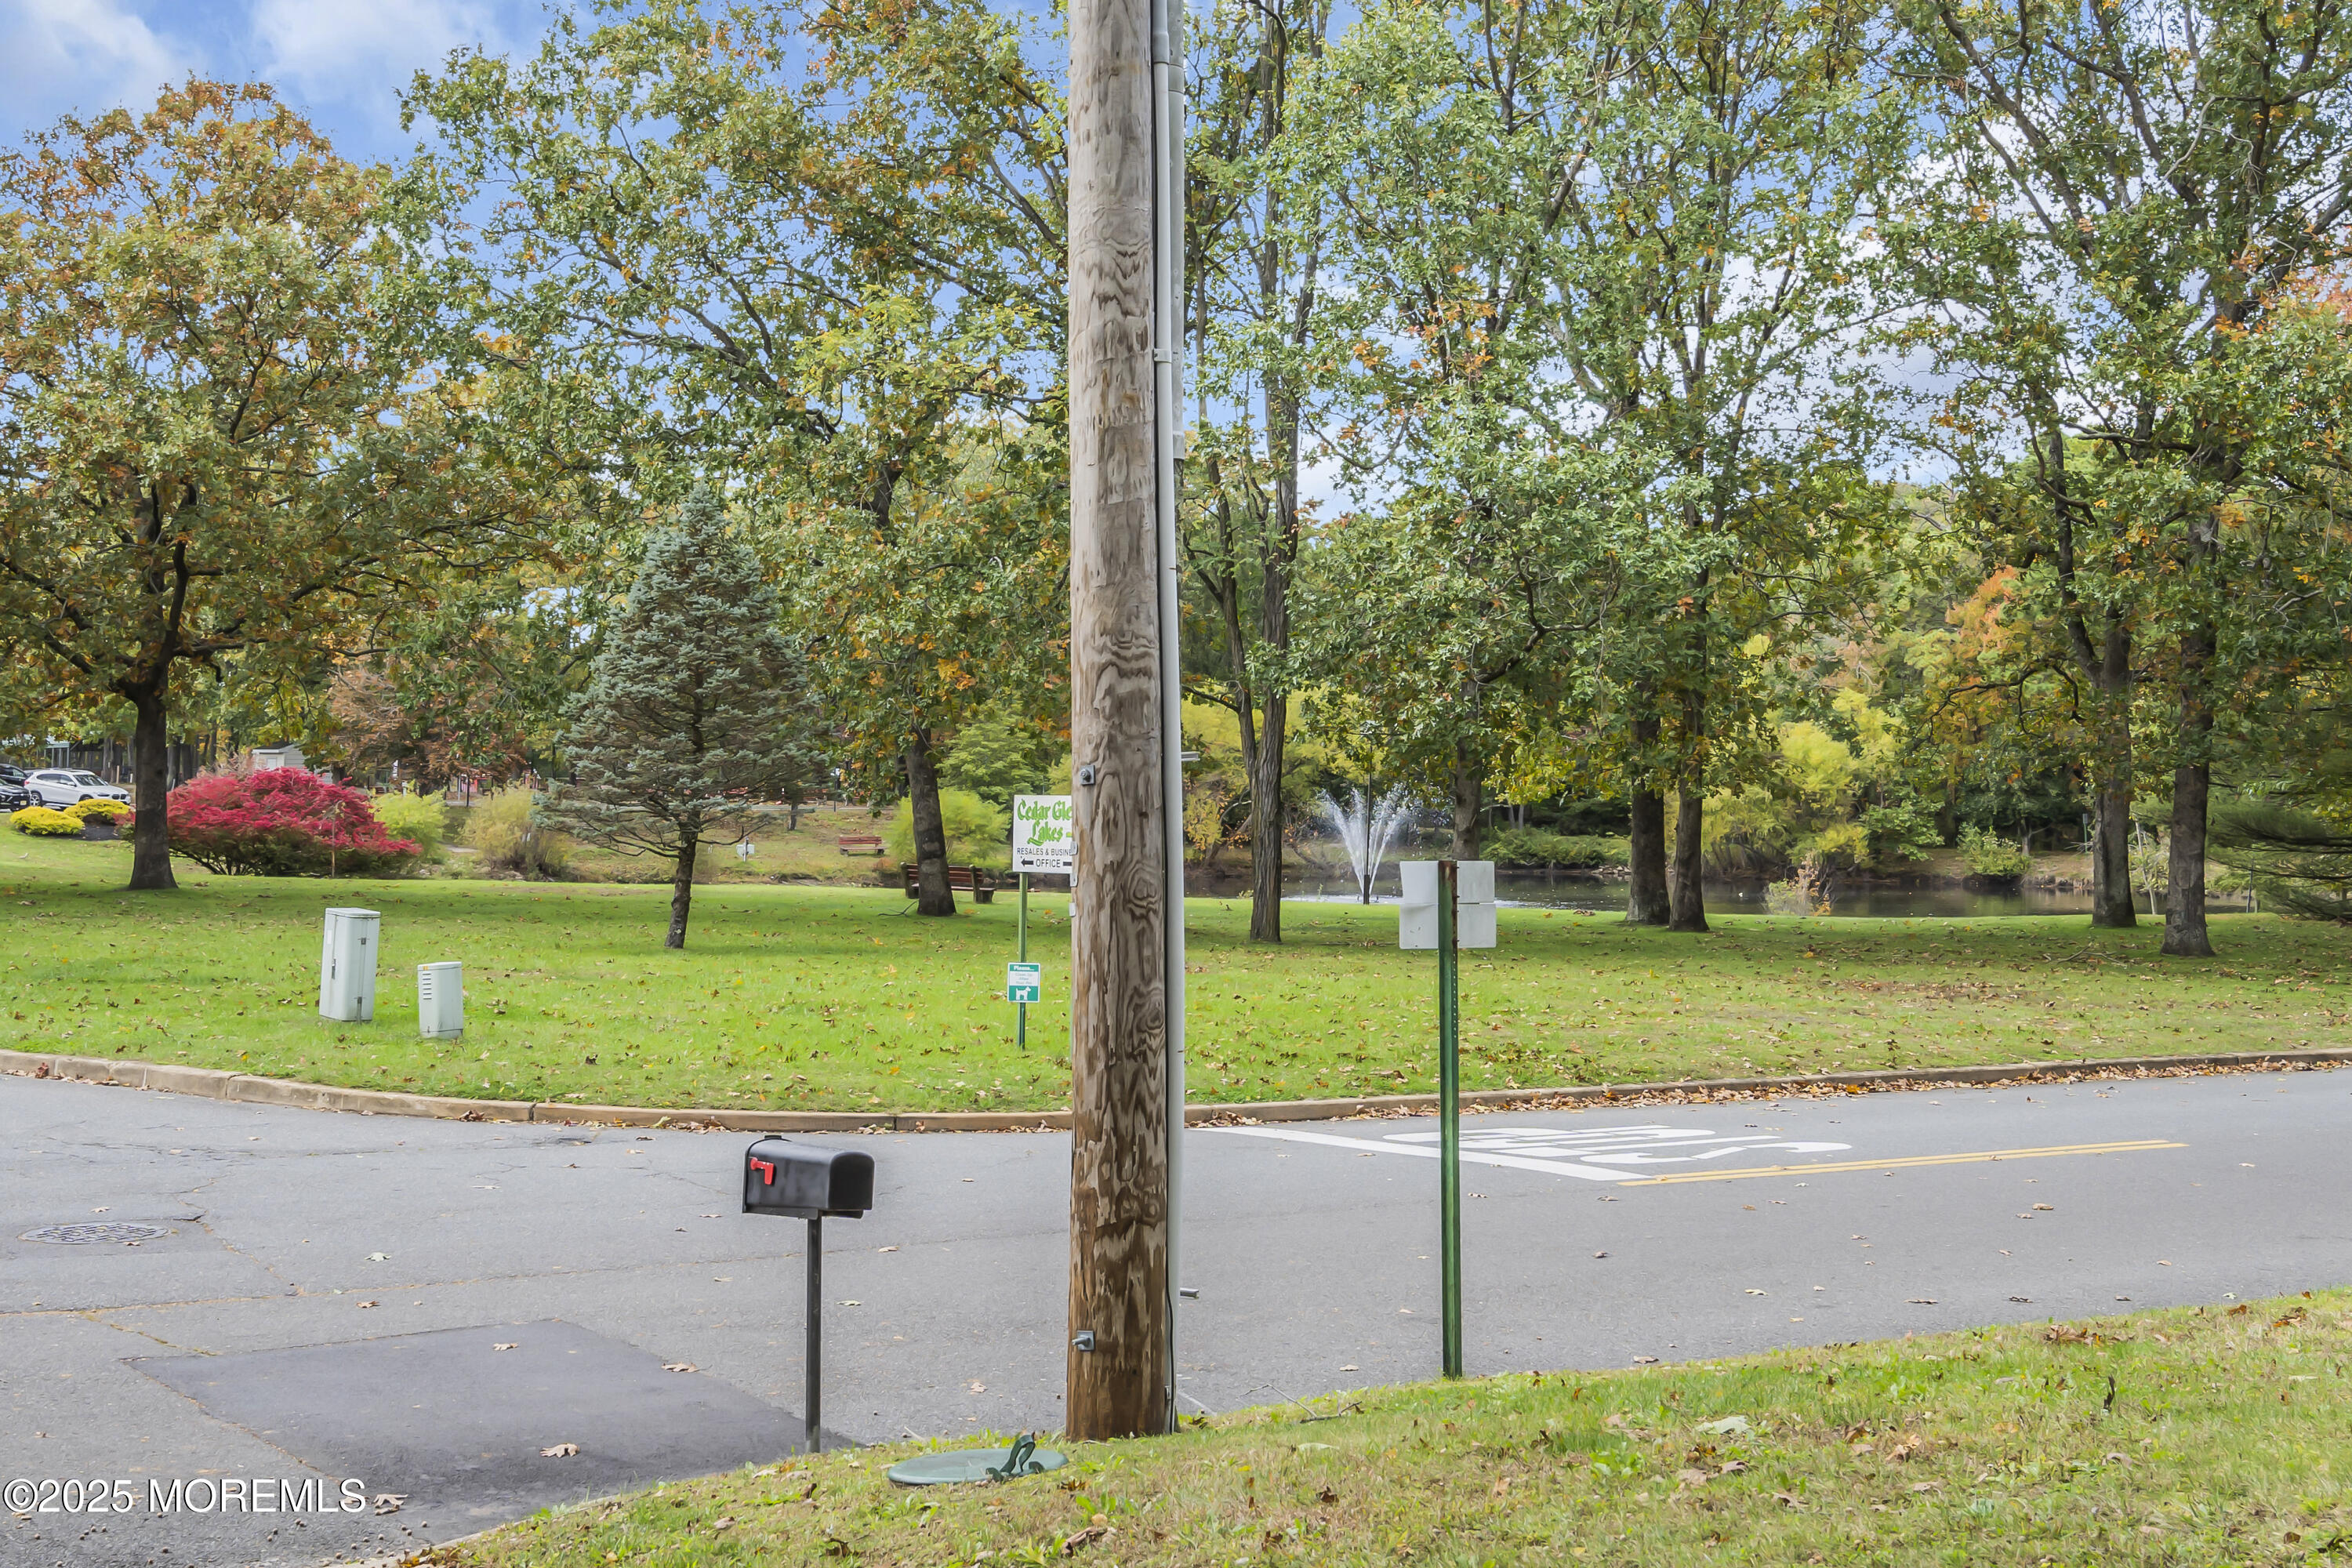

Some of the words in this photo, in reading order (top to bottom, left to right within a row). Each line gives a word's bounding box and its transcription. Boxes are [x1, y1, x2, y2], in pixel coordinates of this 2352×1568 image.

[1018, 799, 1051, 821] Cedar
[1052, 800, 1072, 821] Gle
[1027, 820, 1063, 846] Lakes
[1036, 858, 1060, 868] OFFICE
